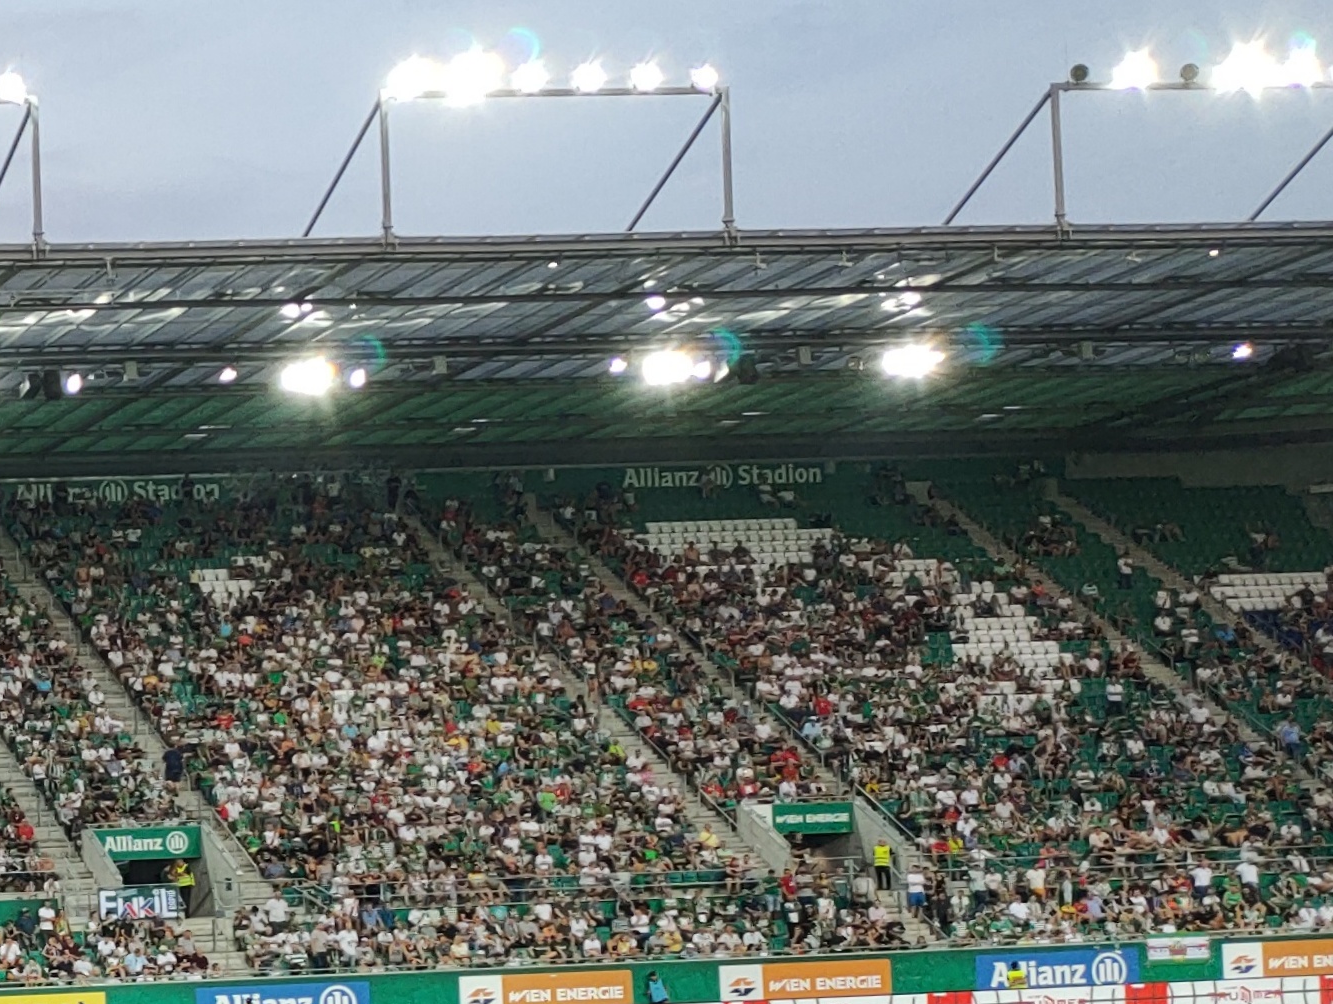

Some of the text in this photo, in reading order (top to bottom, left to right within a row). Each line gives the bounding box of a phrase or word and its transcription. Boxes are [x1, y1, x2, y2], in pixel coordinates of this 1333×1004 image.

[622, 467, 699, 488] Allianz
[104, 834, 164, 853] Allianz
[1268, 955, 1309, 969] WIEN
[768, 975, 882, 992] WIEN ENERGIE
[508, 985, 625, 1003] WIEN ENERGIE
